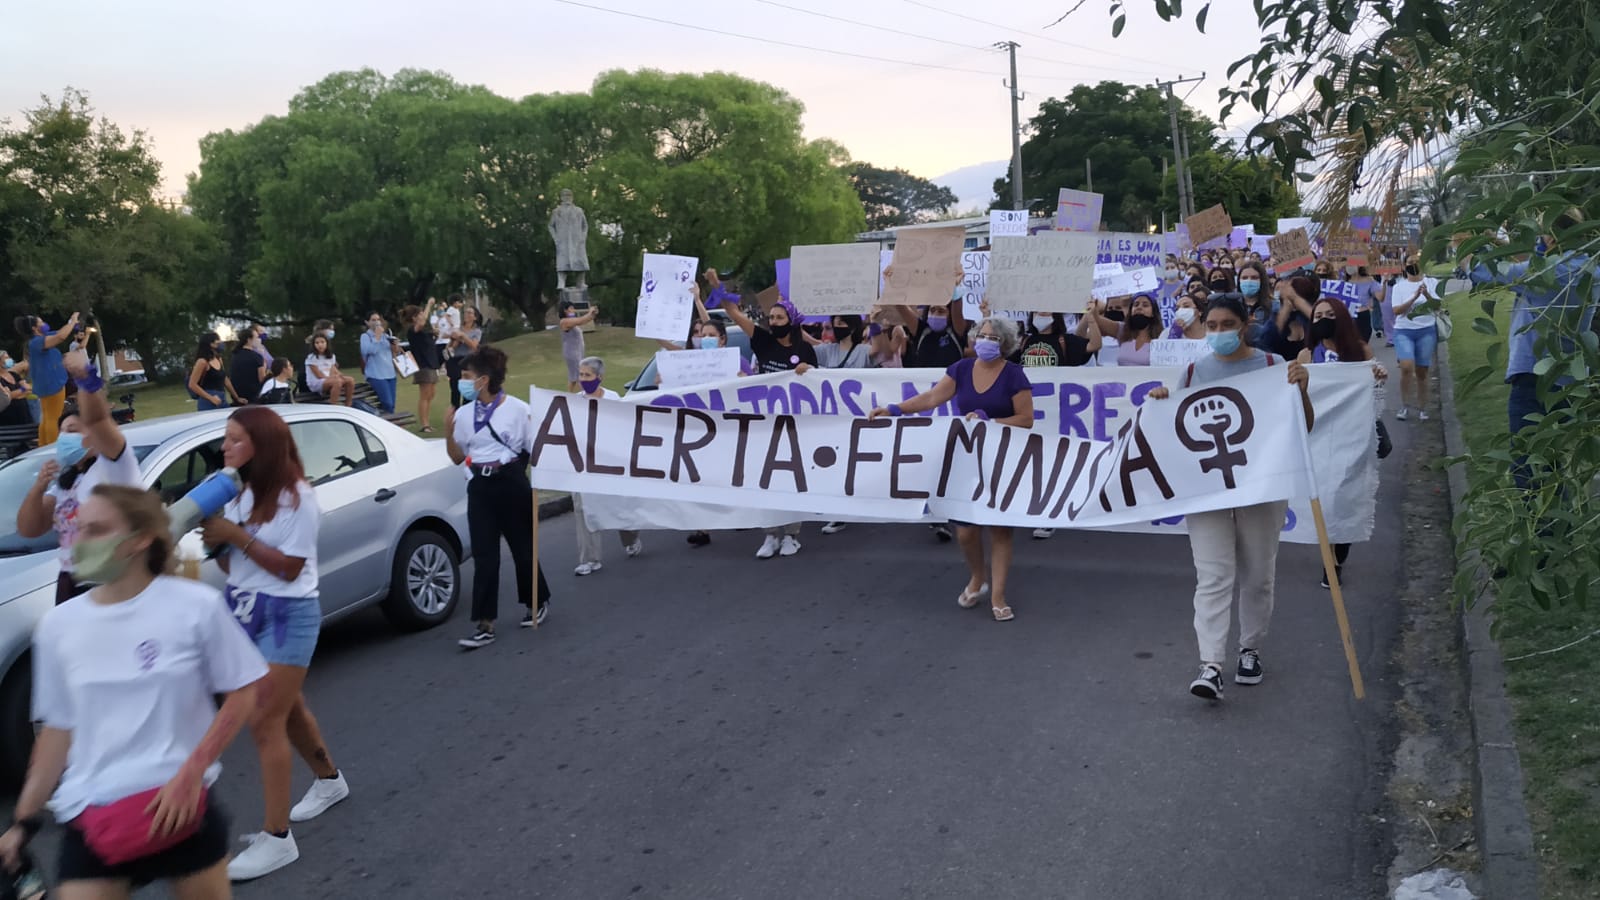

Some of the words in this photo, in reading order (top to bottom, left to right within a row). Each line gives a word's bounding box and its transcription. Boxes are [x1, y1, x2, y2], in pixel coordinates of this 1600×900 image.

[1000, 212, 1022, 222] SON
[1119, 240, 1131, 252] ES
[1137, 241, 1160, 253] UNA
[1096, 253, 1112, 264] RO
[1115, 255, 1160, 268] HERMANA
[963, 273, 988, 290] GRI
[966, 293, 982, 304] QU
[531, 395, 808, 493] ALERTA
[844, 405, 1175, 521] FEMINISTA
